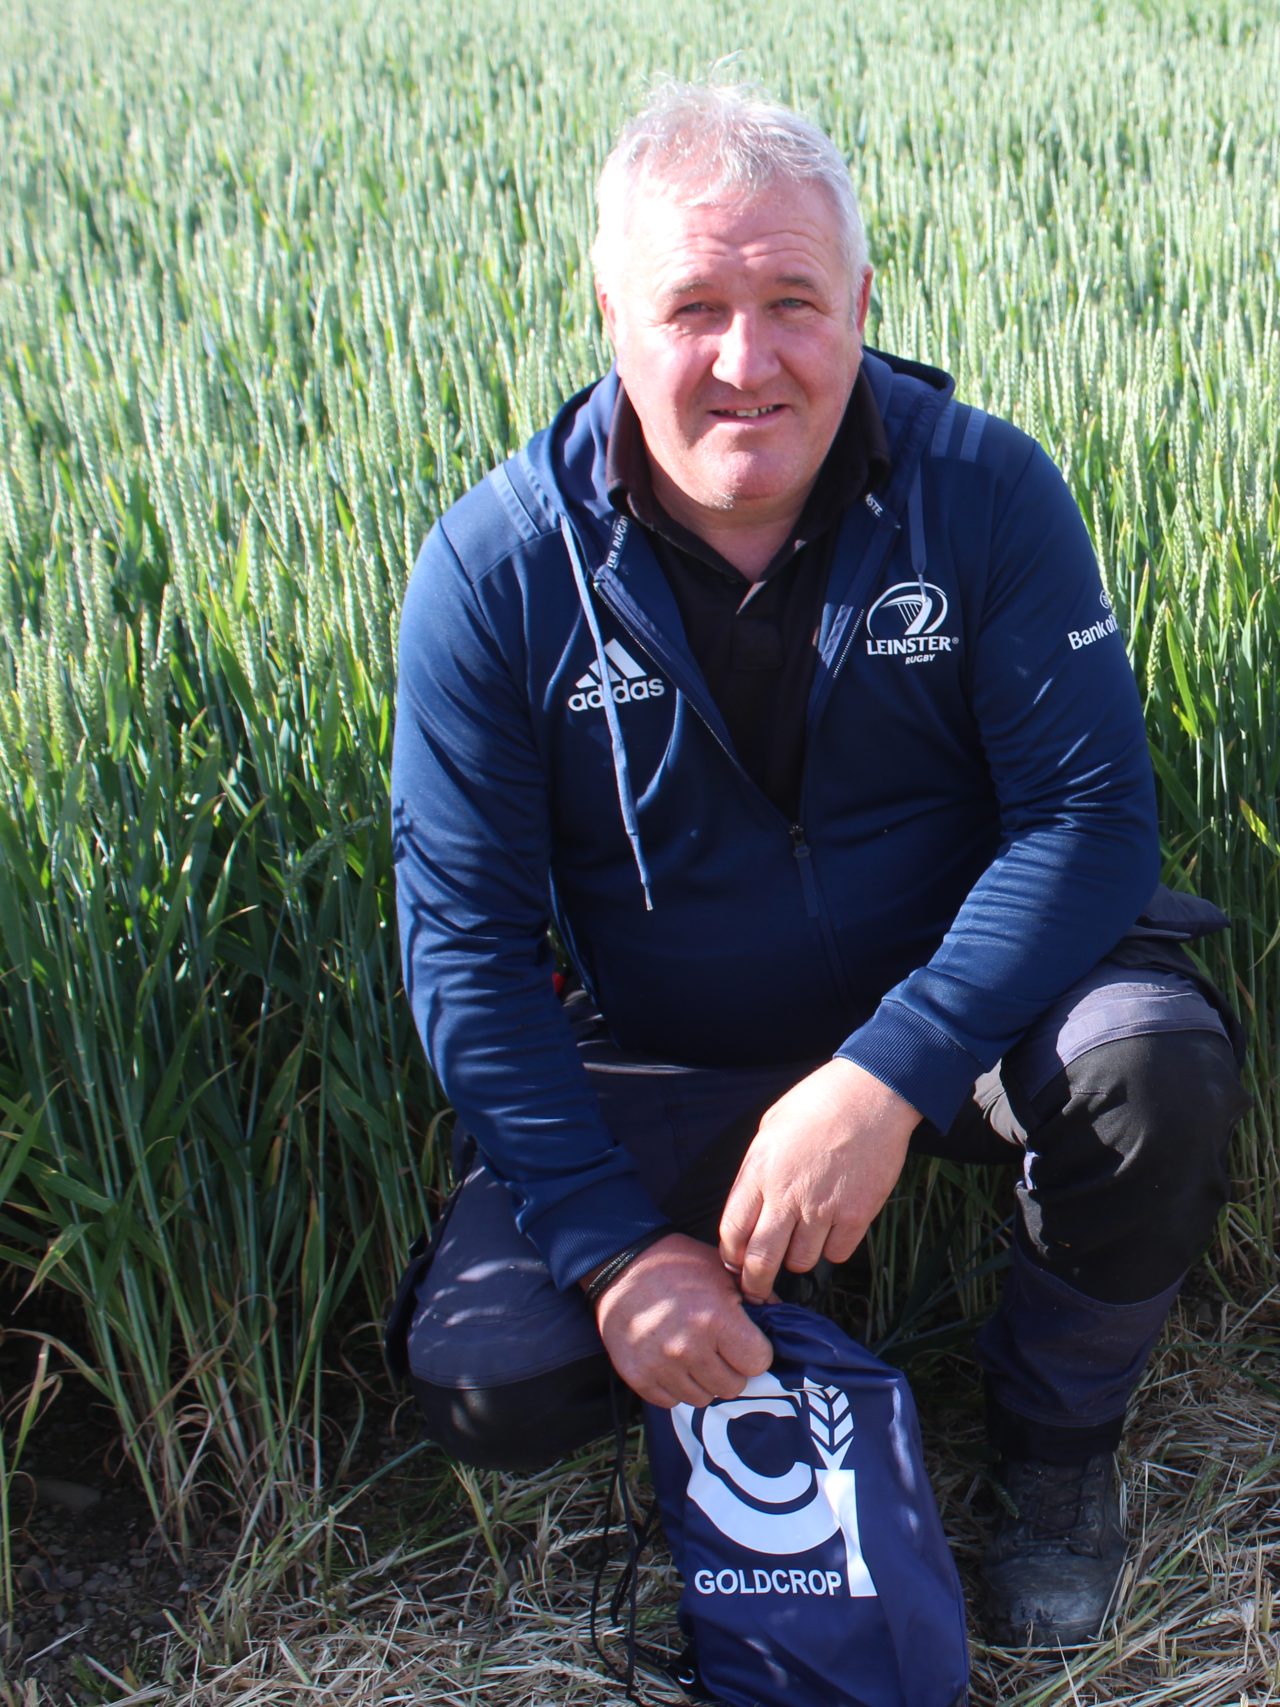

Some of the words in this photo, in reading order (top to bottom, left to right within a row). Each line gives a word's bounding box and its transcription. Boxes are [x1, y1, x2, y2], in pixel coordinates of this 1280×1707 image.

[1067, 621, 1108, 650] Bank
[905, 653, 936, 665] RUGBY
[568, 678, 665, 712] addas
[694, 1568, 842, 1596] GOLDCROP
